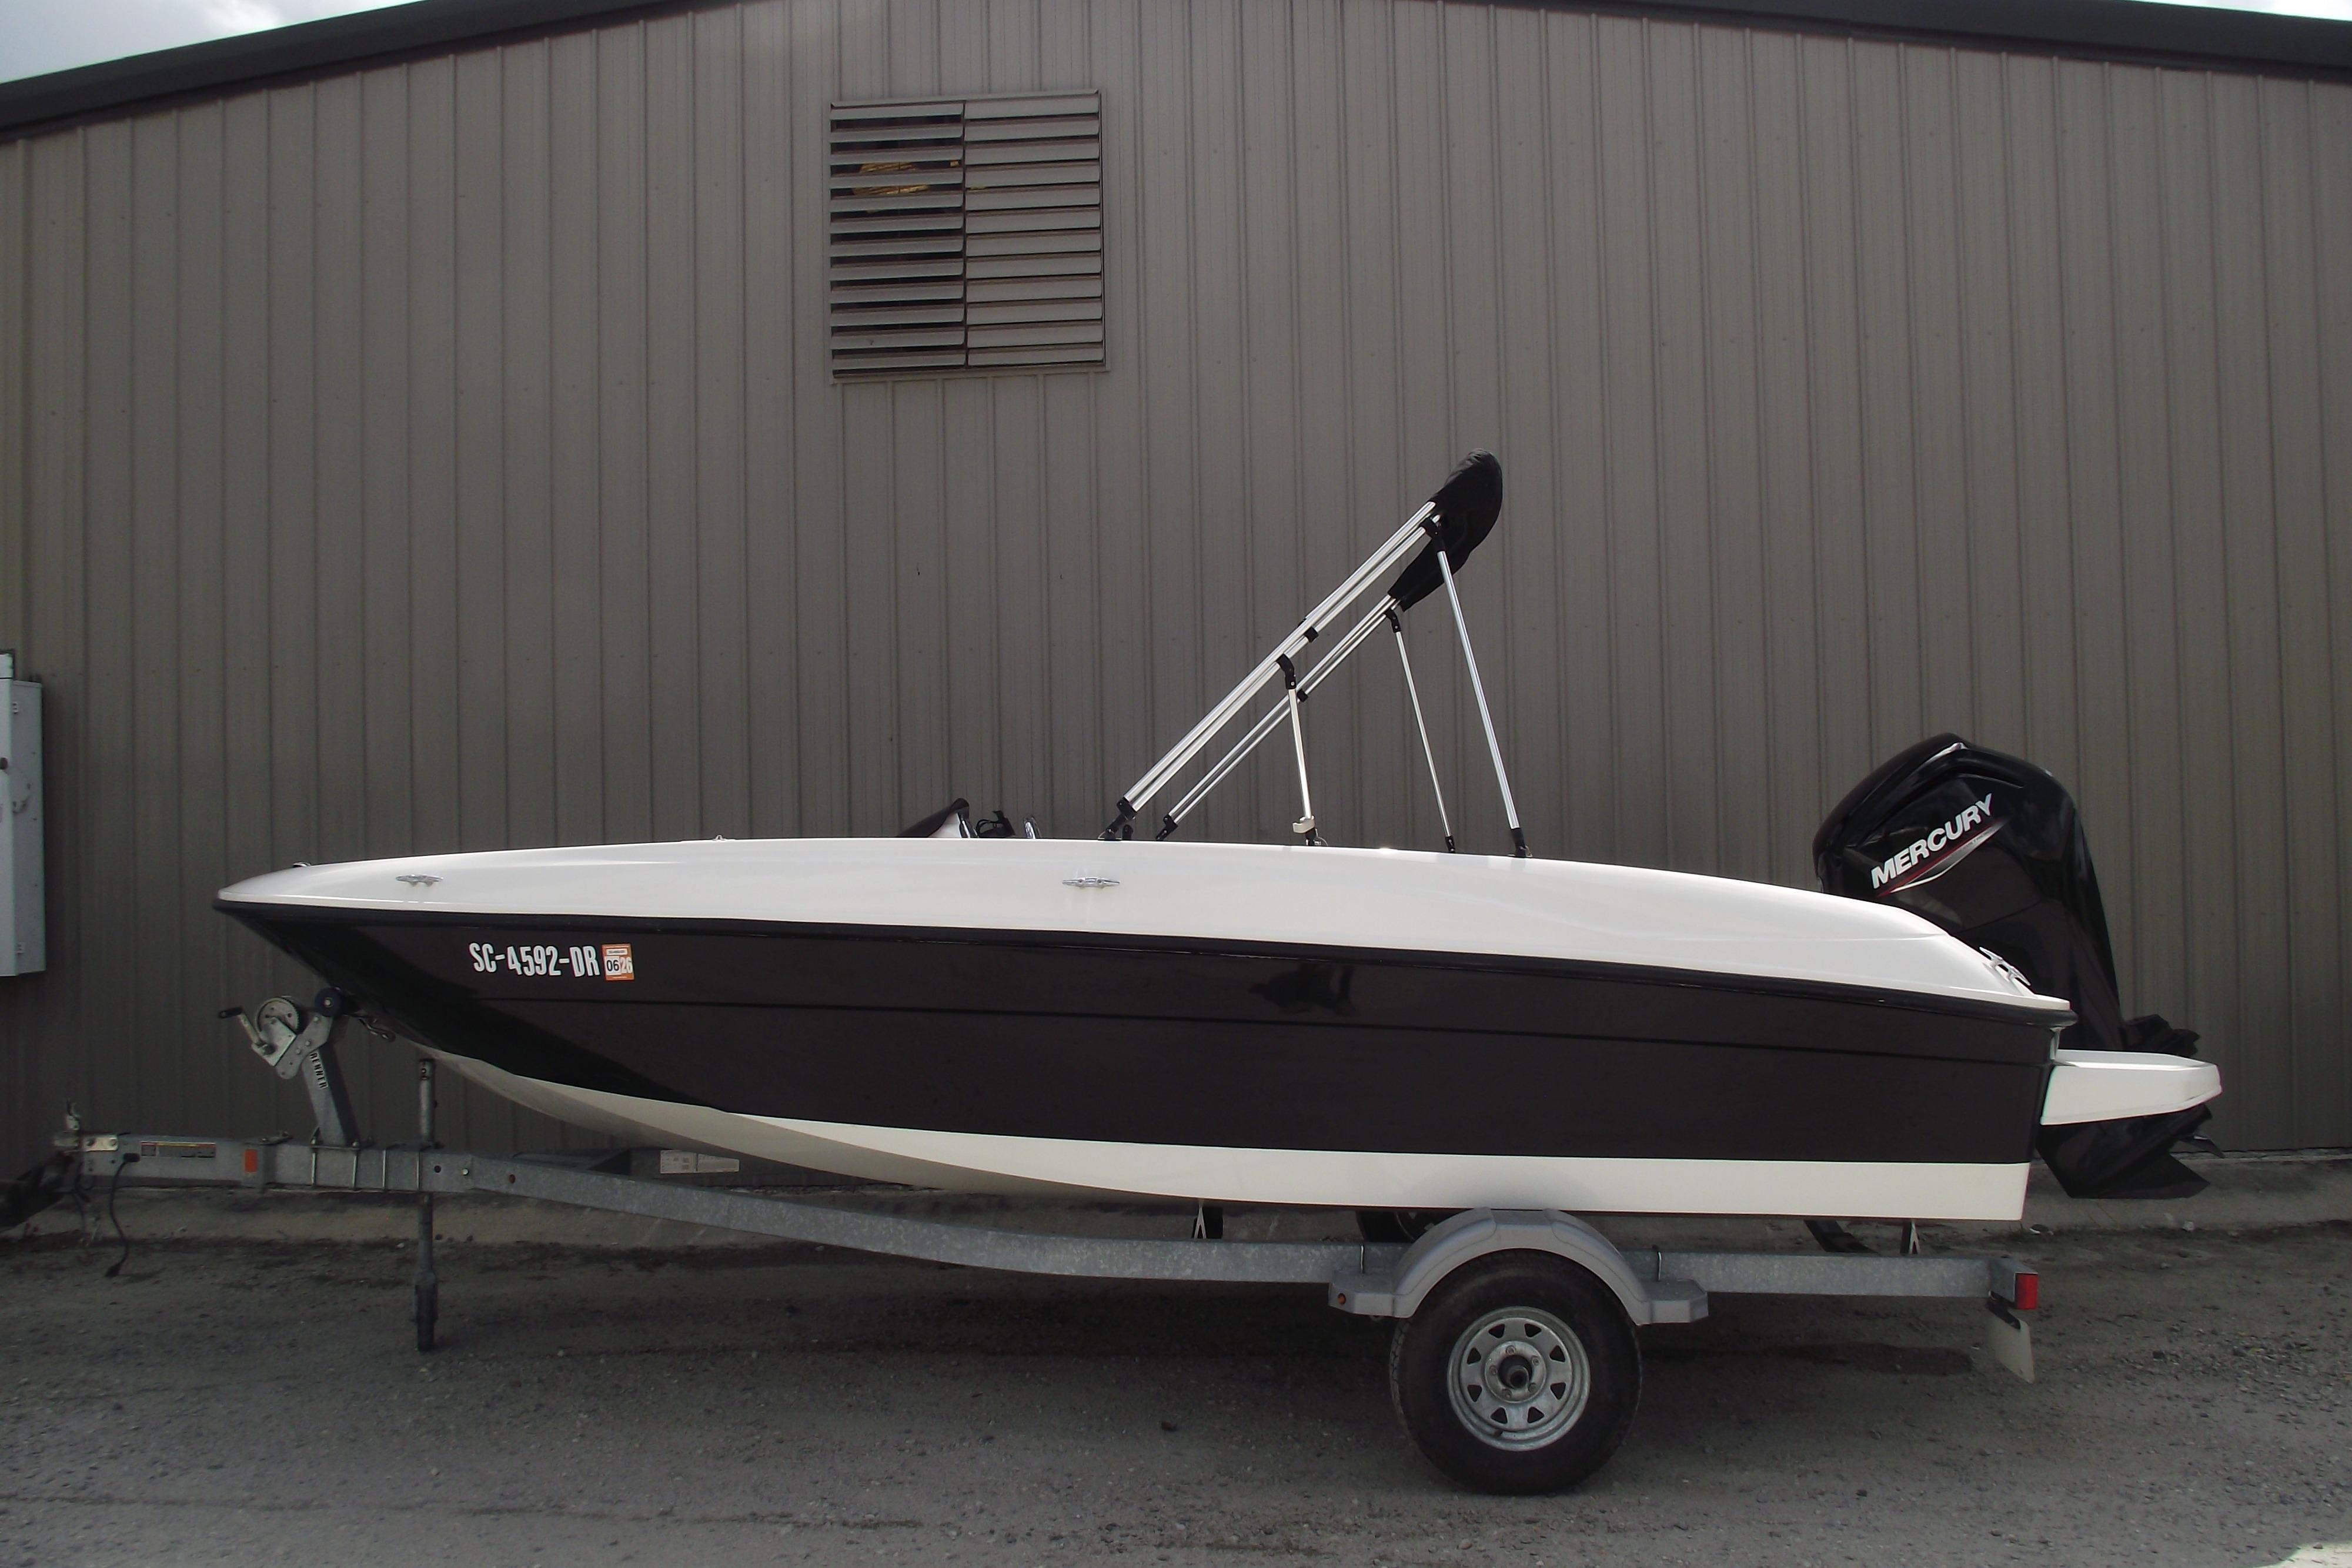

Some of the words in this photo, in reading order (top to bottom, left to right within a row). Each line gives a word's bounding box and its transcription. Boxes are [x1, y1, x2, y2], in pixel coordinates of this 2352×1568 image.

[1870, 793, 1992, 889] MERCURY
[469, 942, 600, 977] SC-4592-DR
[606, 959, 620, 971] 06
[620, 957, 633, 974] 26
